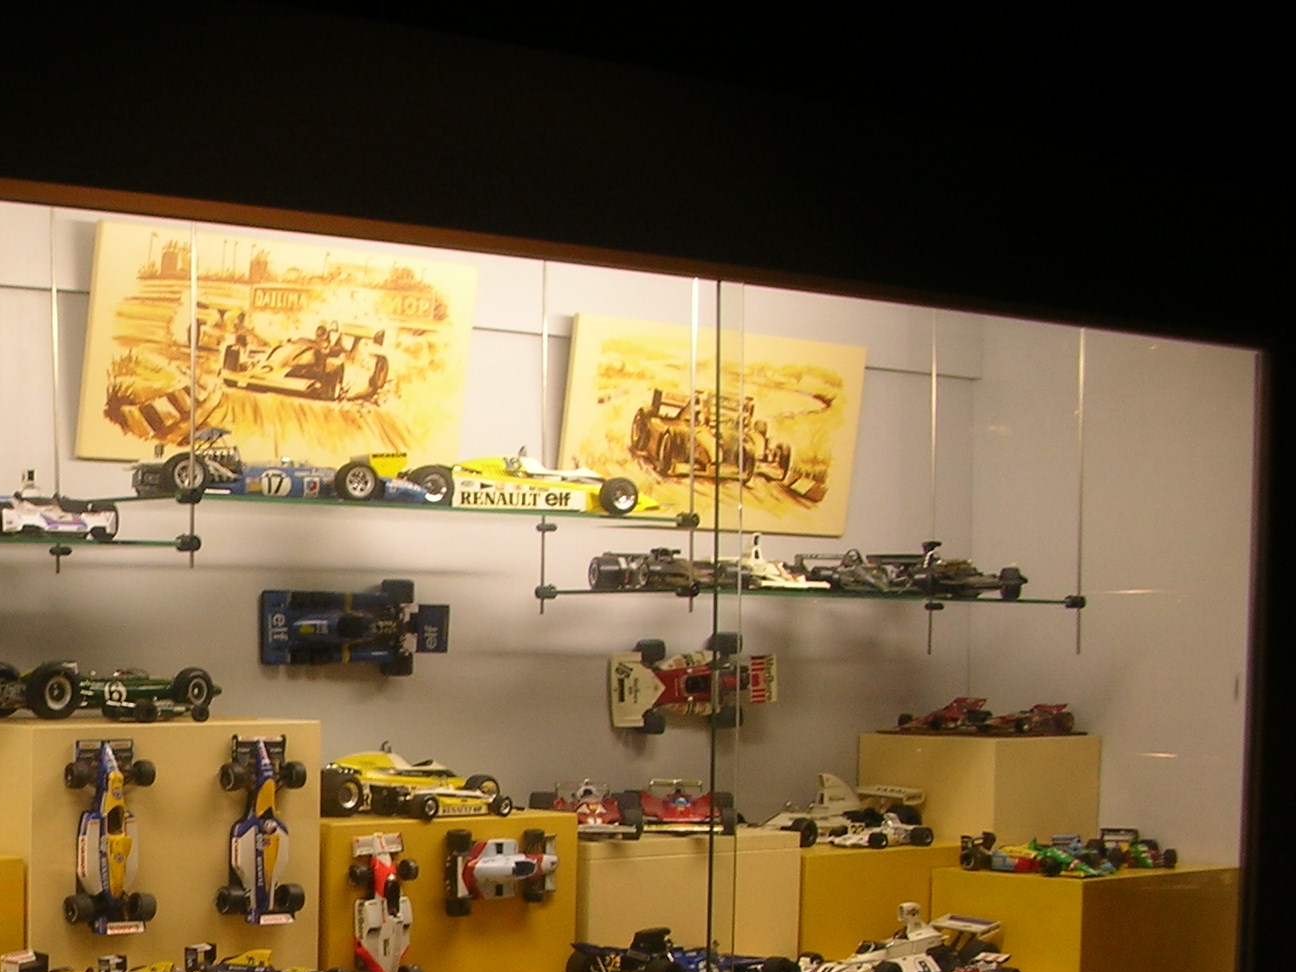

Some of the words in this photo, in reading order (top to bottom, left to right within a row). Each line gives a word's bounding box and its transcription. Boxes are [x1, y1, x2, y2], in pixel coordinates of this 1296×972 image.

[266, 472, 284, 494] 17
[460, 491, 541, 507] RENAULT
[544, 492, 572, 507] elf
[423, 625, 439, 650] elf
